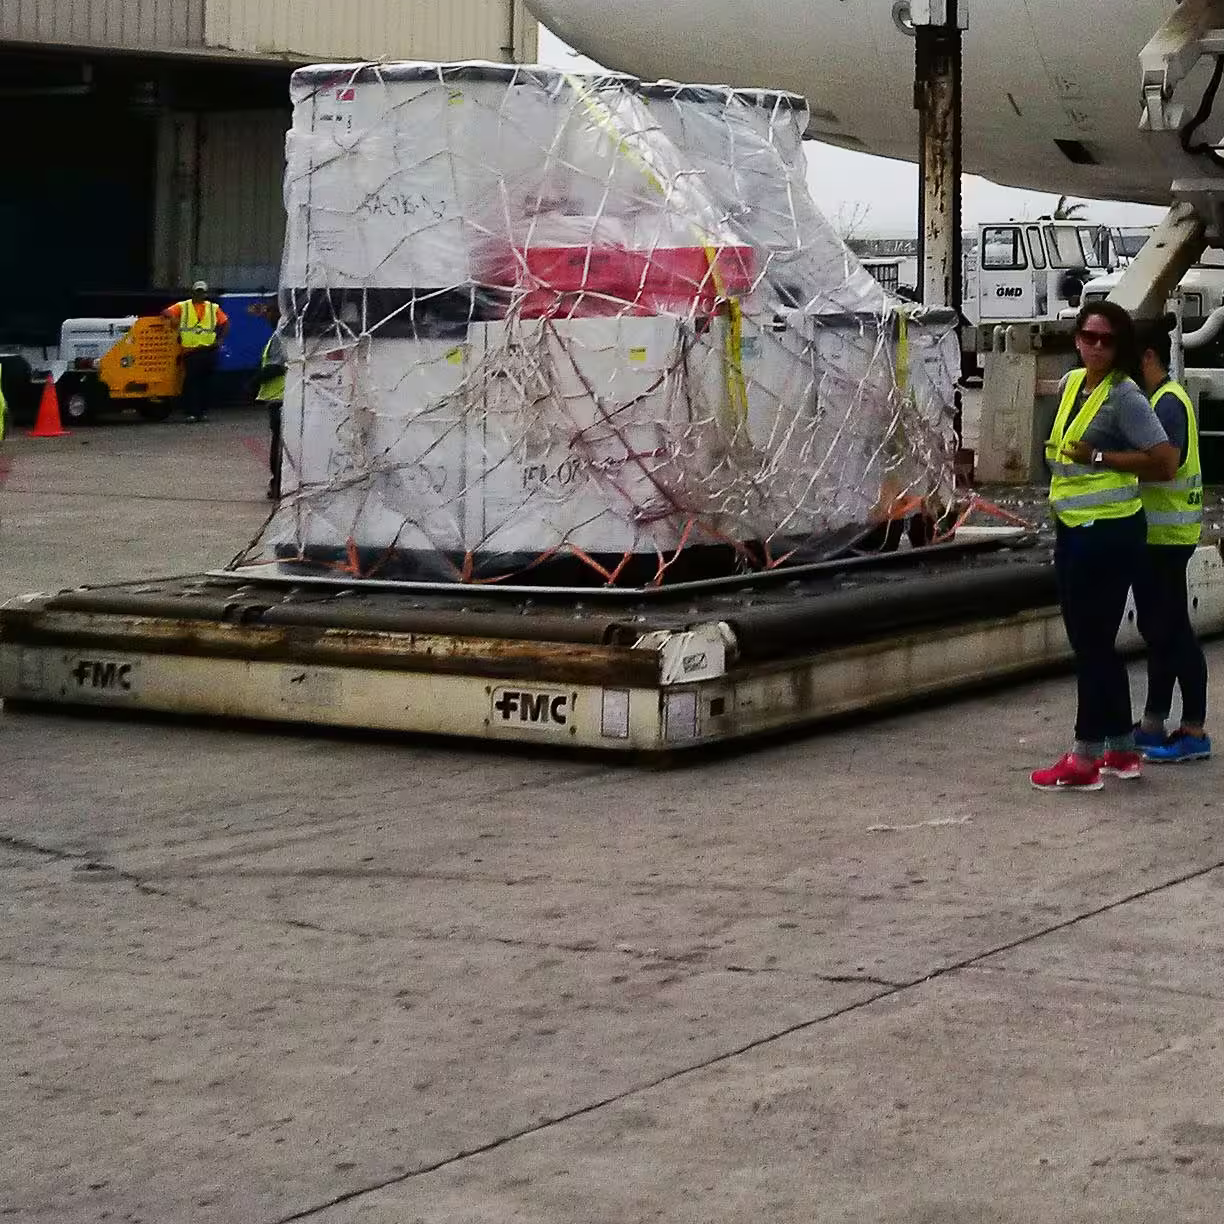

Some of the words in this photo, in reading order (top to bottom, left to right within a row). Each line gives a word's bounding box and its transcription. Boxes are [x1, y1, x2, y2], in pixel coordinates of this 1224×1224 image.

[996, 287, 1023, 297] GMD
[73, 660, 132, 690] FMC
[494, 691, 567, 725] FMC
